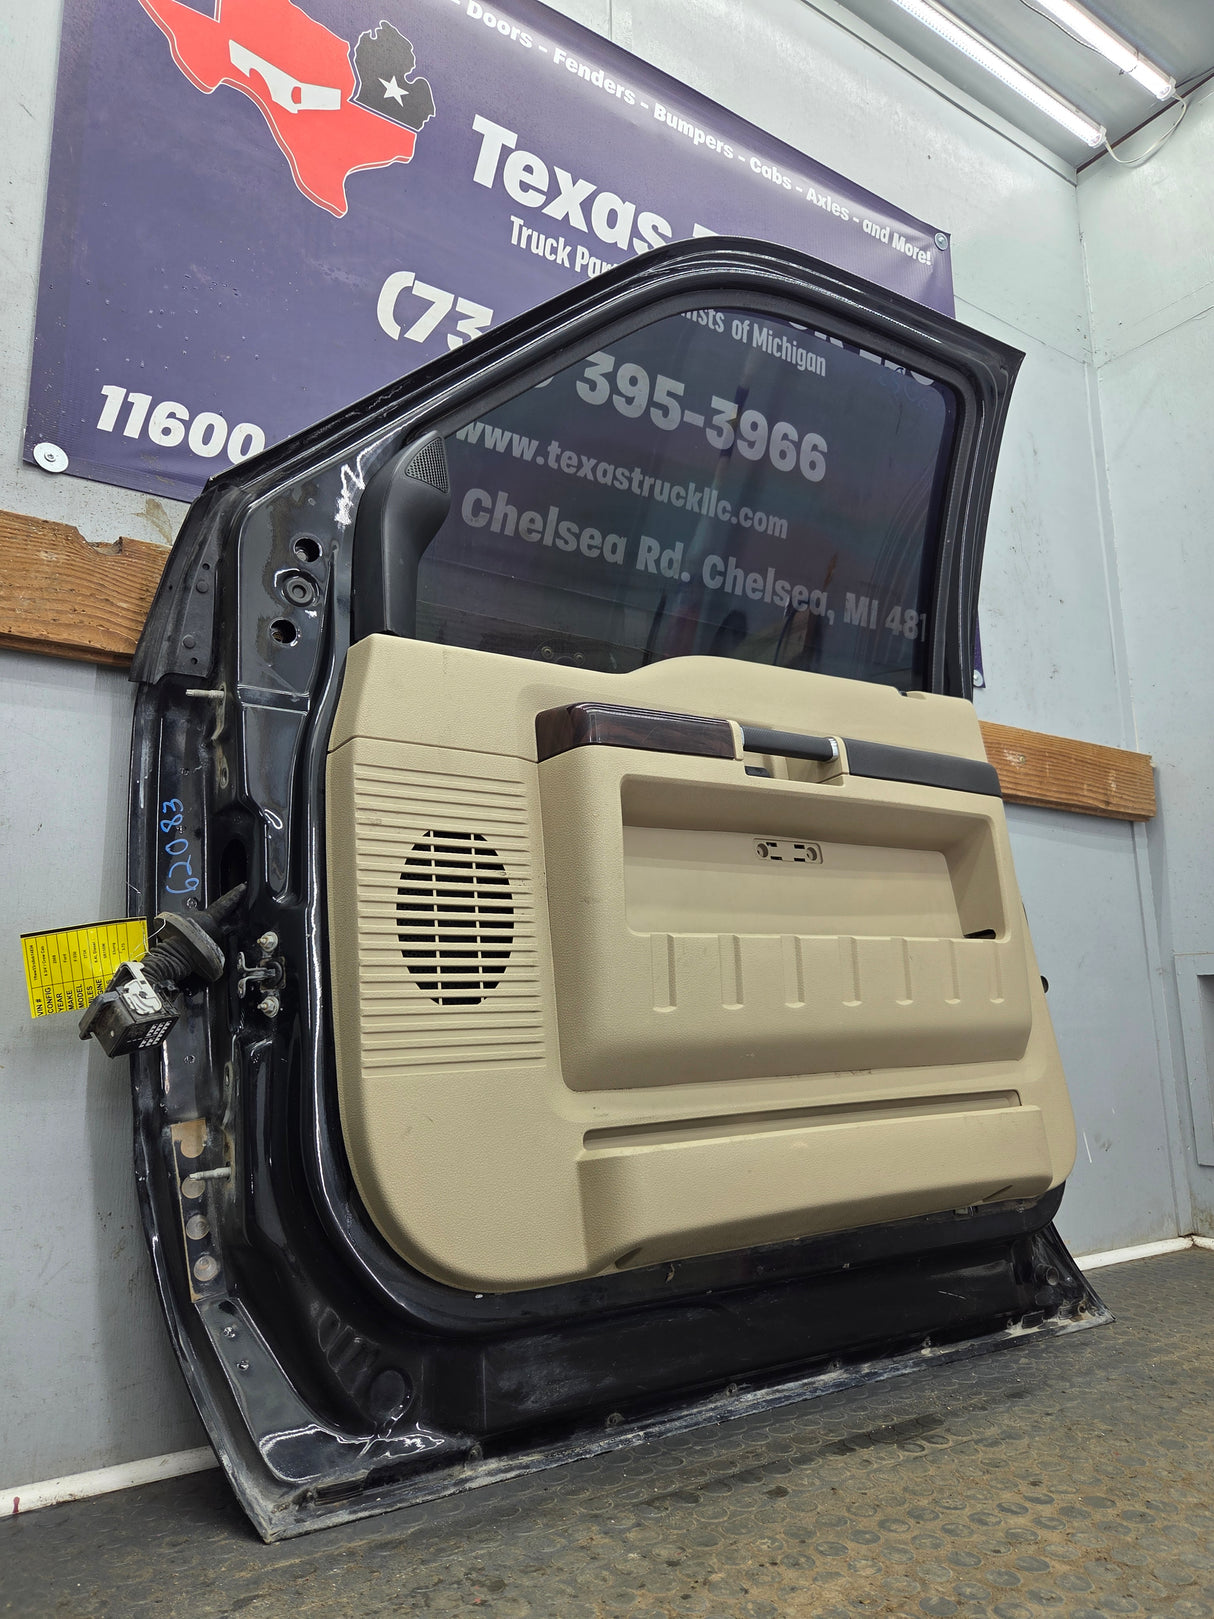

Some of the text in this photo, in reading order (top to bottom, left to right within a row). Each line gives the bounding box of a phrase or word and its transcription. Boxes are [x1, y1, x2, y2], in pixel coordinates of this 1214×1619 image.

[466, 0, 533, 49] Doors
[553, 47, 636, 106] Fenders
[653, 102, 734, 159] Bumpers
[749, 156, 792, 190] Cabs
[806, 187, 850, 221] Axles
[862, 219, 890, 244] and
[892, 232, 932, 266] More!
[472, 113, 673, 256] Texas
[510, 215, 620, 278] Truck Par
[377, 271, 494, 351] (73
[731, 319, 750, 344] of
[752, 323, 826, 377] Michigan
[97, 384, 266, 466] 11600
[576, 350, 827, 482] 395-3966
[455, 420, 788, 539] www.texastruckllc.com
[461, 488, 926, 642] Chelsea Rd. Chelsea, MI 481
[45, 987, 54, 1014] CONFIG
[56, 993, 64, 1012] YEAR
[66, 990, 74, 1010] MAKE
[76, 984, 84, 1008] MODEL
